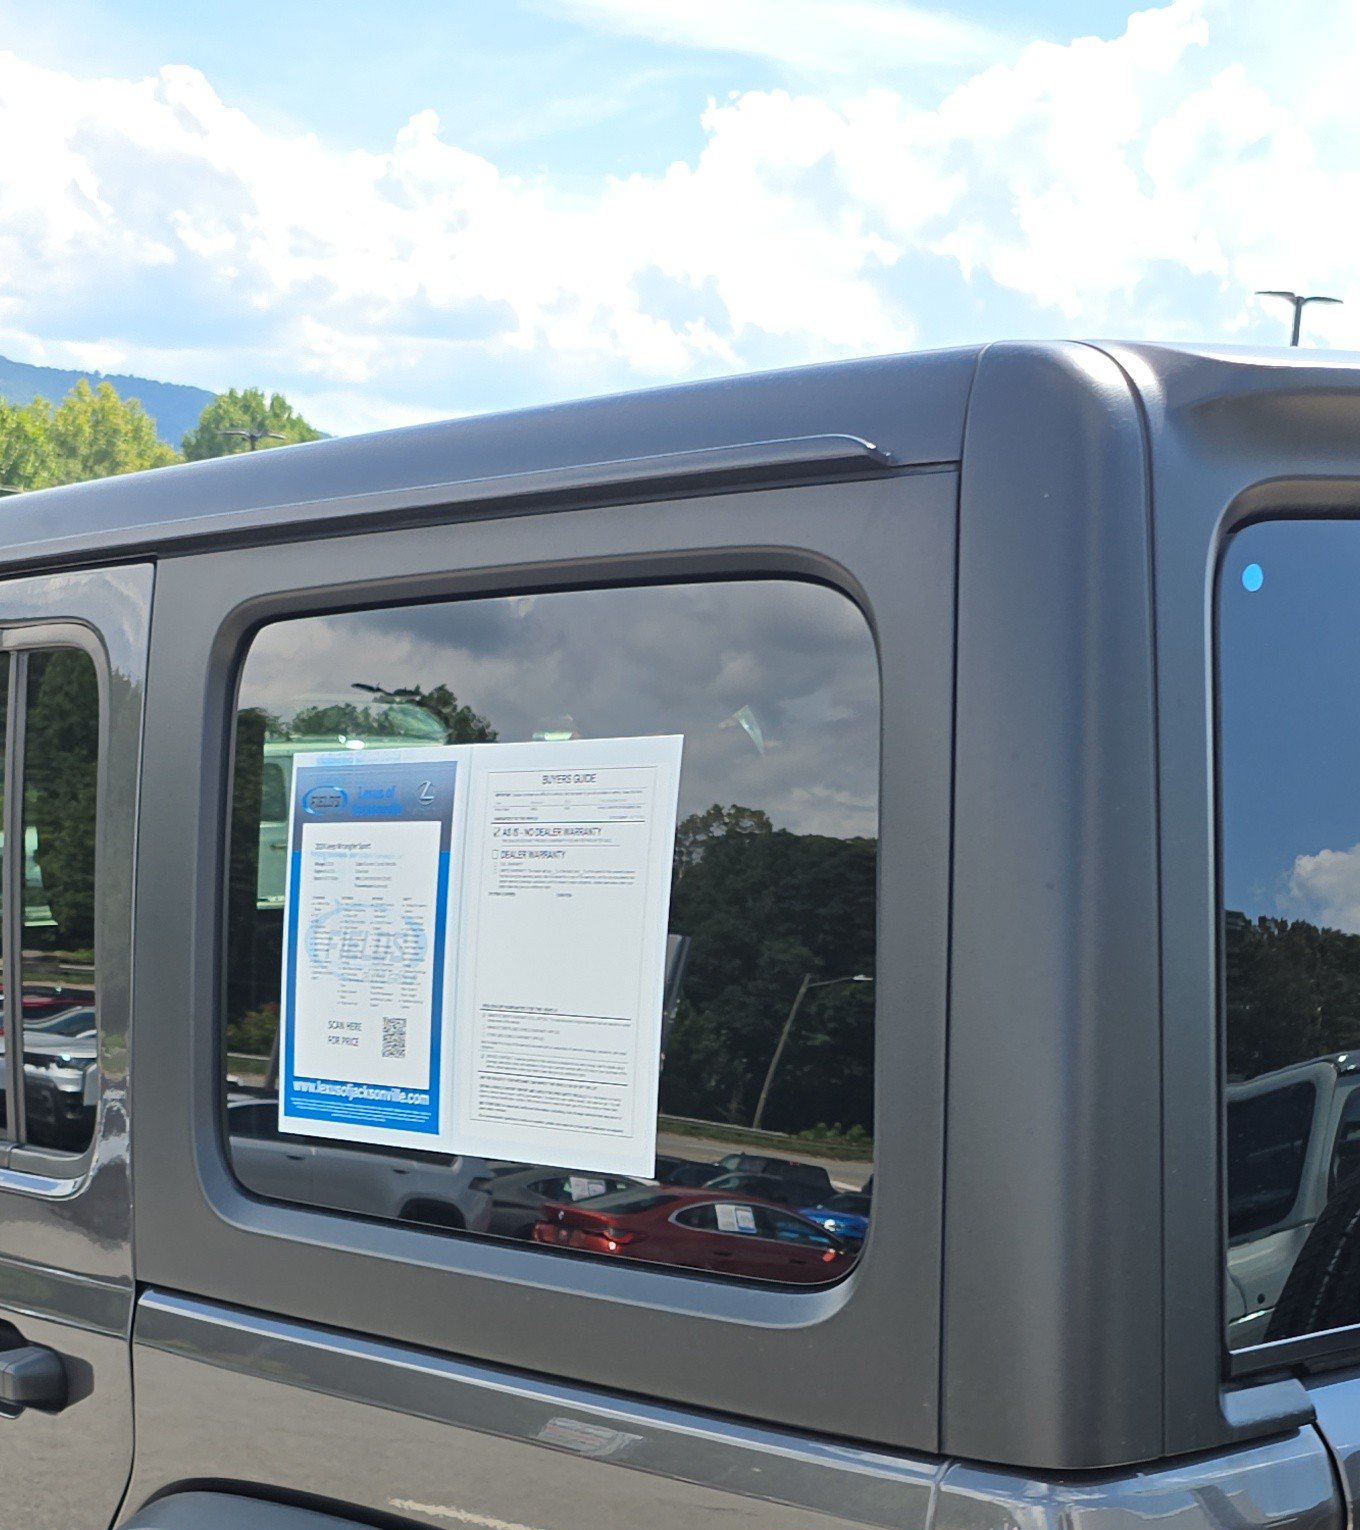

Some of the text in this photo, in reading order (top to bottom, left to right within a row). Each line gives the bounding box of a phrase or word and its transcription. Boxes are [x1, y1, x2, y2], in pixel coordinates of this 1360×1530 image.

[542, 773, 597, 785] BUYERS GUIDE
[535, 827, 562, 836] DEALER
[564, 827, 602, 836] WARRANTY
[500, 850, 566, 860] DEALER WARRANTY
[328, 1020, 363, 1032] SCAN HERE
[328, 1035, 360, 1047] FOR PRICE
[292, 1080, 430, 1106] www.lexusofjacksonville.com
